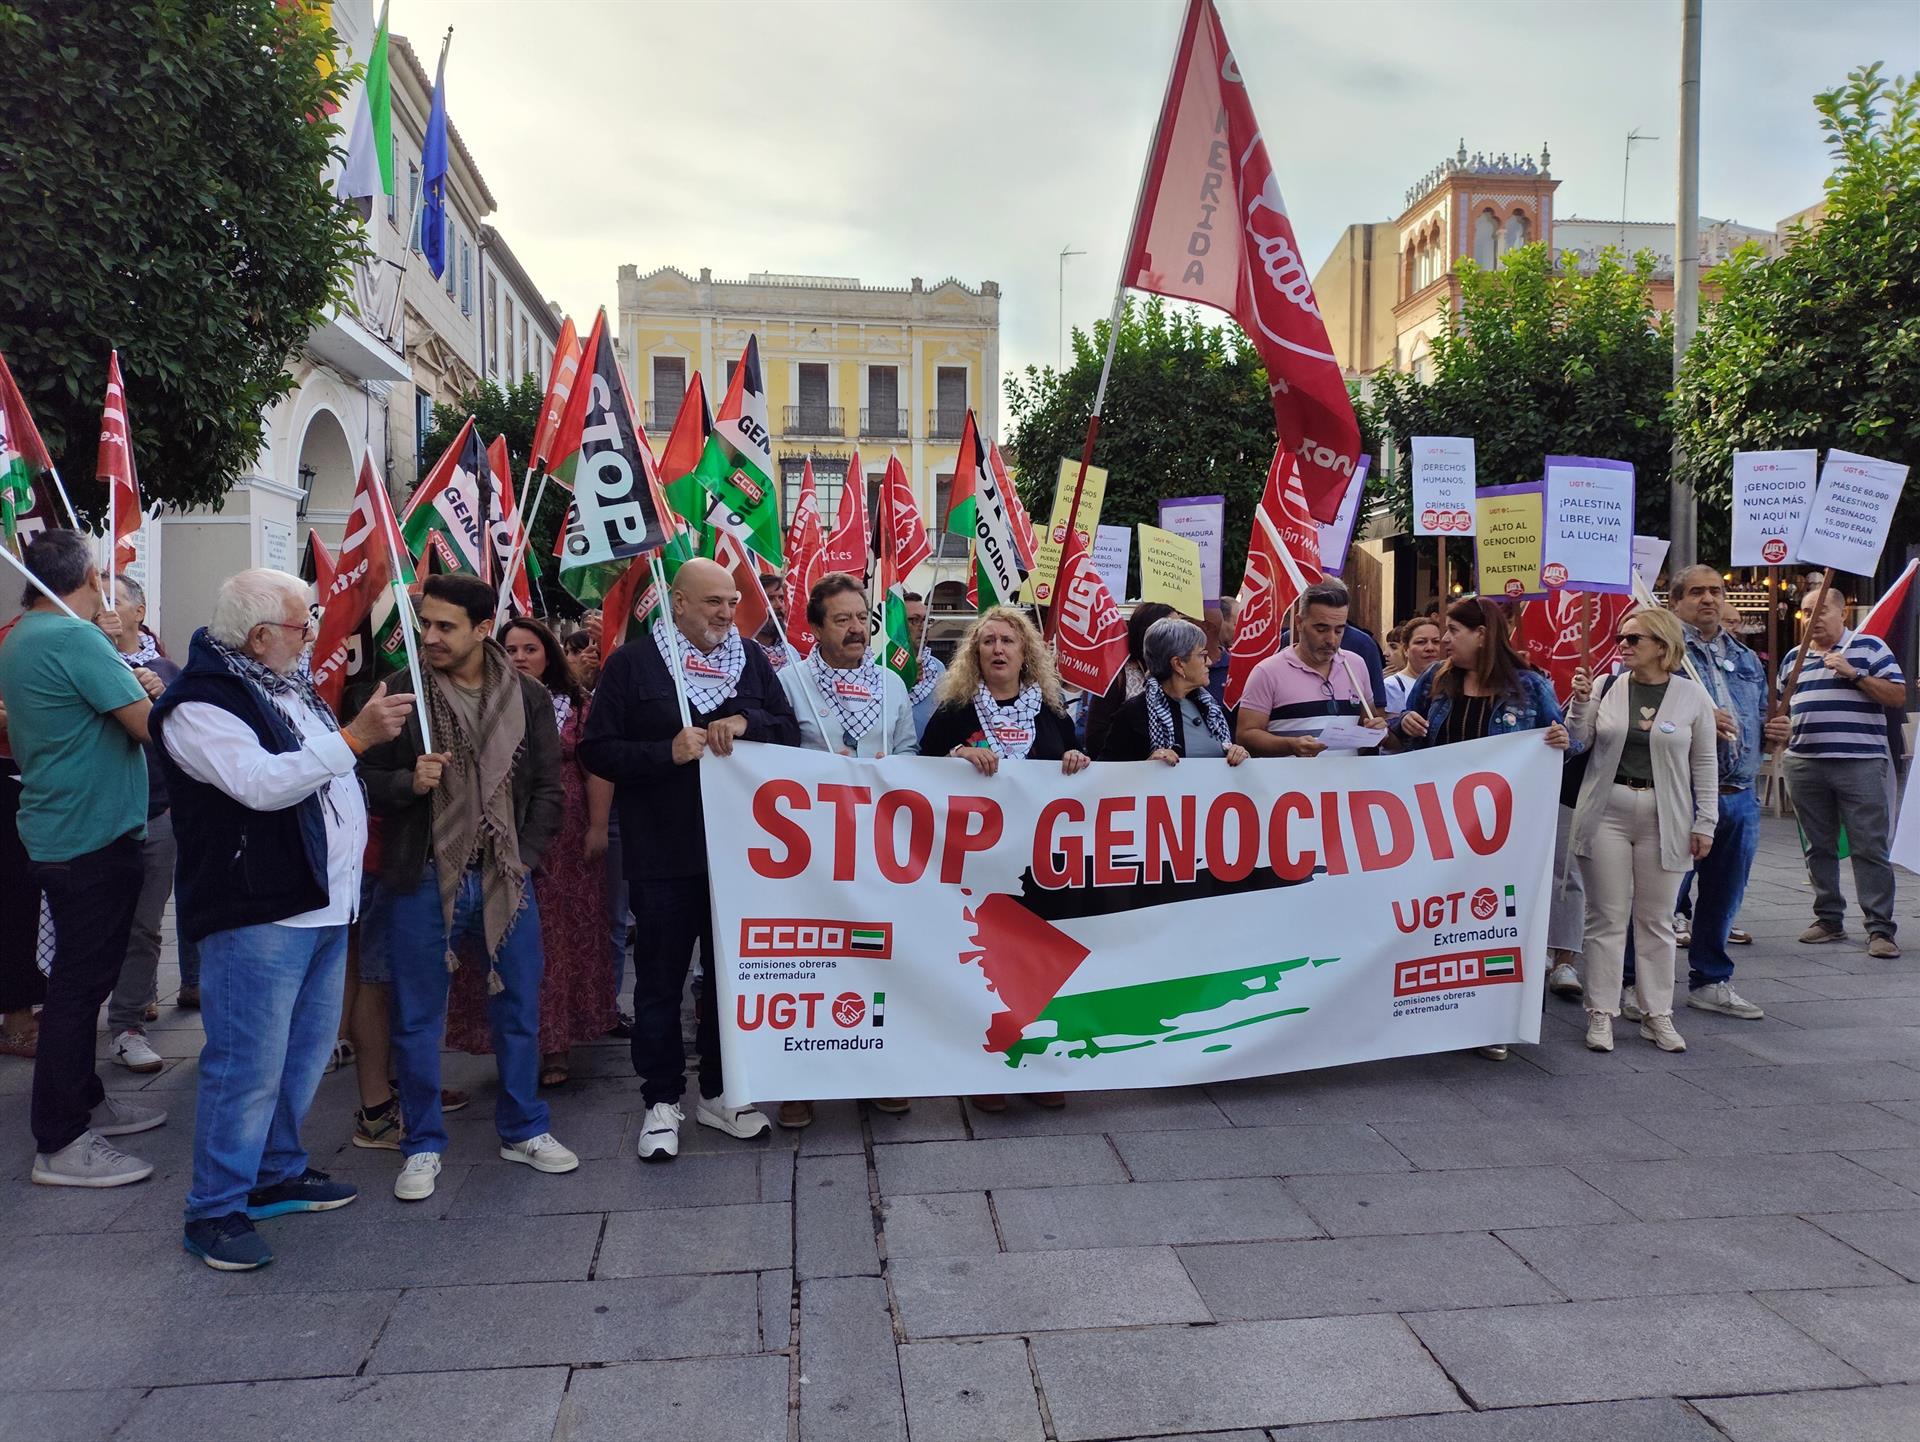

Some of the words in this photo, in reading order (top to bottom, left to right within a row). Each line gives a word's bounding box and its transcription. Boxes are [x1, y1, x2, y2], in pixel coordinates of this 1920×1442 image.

[585, 372, 648, 546] STOP
[1421, 463, 1467, 472] ¡DERECHOS
[1843, 465, 1858, 474] UGT
[732, 472, 762, 501] CCOO
[1422, 477, 1466, 485] HUMANOS,
[1744, 481, 1806, 493] ¡GENOCIDIO
[1063, 484, 1097, 499] ¡DECHOS
[1851, 485, 1863, 494] DE
[1864, 489, 1889, 501] 60.000
[1062, 495, 1094, 510] HUNOS,
[1425, 501, 1466, 509] CRÍMENES
[1560, 498, 1622, 511] ¡PALESTINA
[1743, 498, 1780, 506] NUNCA
[1831, 493, 1880, 511] PALESTINOS
[1560, 514, 1594, 525] LIBRE,
[1597, 516, 1621, 527] VIVA
[1750, 513, 1760, 521] NI
[1762, 510, 1787, 521] AQUÍ
[1789, 511, 1800, 519] NI
[1824, 505, 1879, 524] ASESINADOS,
[1059, 518, 1089, 531] CRENES
[1490, 523, 1514, 533] ¡ALTO
[1515, 522, 1527, 530] AL
[1760, 525, 1789, 535] ALLÁ!
[1825, 517, 1850, 528] 15.000
[1850, 524, 1873, 535] ERAN
[1483, 535, 1536, 546] GENOCIDIO
[1561, 530, 1575, 539] LA
[1578, 531, 1618, 543] LUCHA!
[1814, 527, 1840, 540] NIÑOS
[975, 504, 1010, 592] NOCIDIO
[1503, 551, 1516, 559] EN
[1765, 543, 1785, 553] UGT
[1147, 556, 1175, 568] NUNCA
[1148, 547, 1193, 566] ¡GENOCIDIO
[1486, 563, 1537, 574] PALESTINA!
[1061, 557, 1100, 636] UGT
[1061, 650, 1099, 677] www.ug
[747, 779, 1004, 885] STOP
[1031, 770, 1513, 890] GENOCIDIO
[1391, 891, 1466, 934] UGT
[747, 926, 845, 950] CCOO
[1433, 926, 1518, 946] Extremadura
[738, 960, 796, 969] comisiones
[799, 960, 837, 969] obreras
[738, 971, 750, 980] de
[753, 971, 816, 980] extremadura
[1400, 958, 1480, 989] CCOO
[1393, 993, 1441, 1008] comisiones
[1443, 990, 1476, 1001] obreras
[736, 992, 825, 1031] UGT
[1392, 1008, 1403, 1017] de
[1405, 1002, 1459, 1016] extremadura
[784, 1035, 884, 1051] Extremadura
